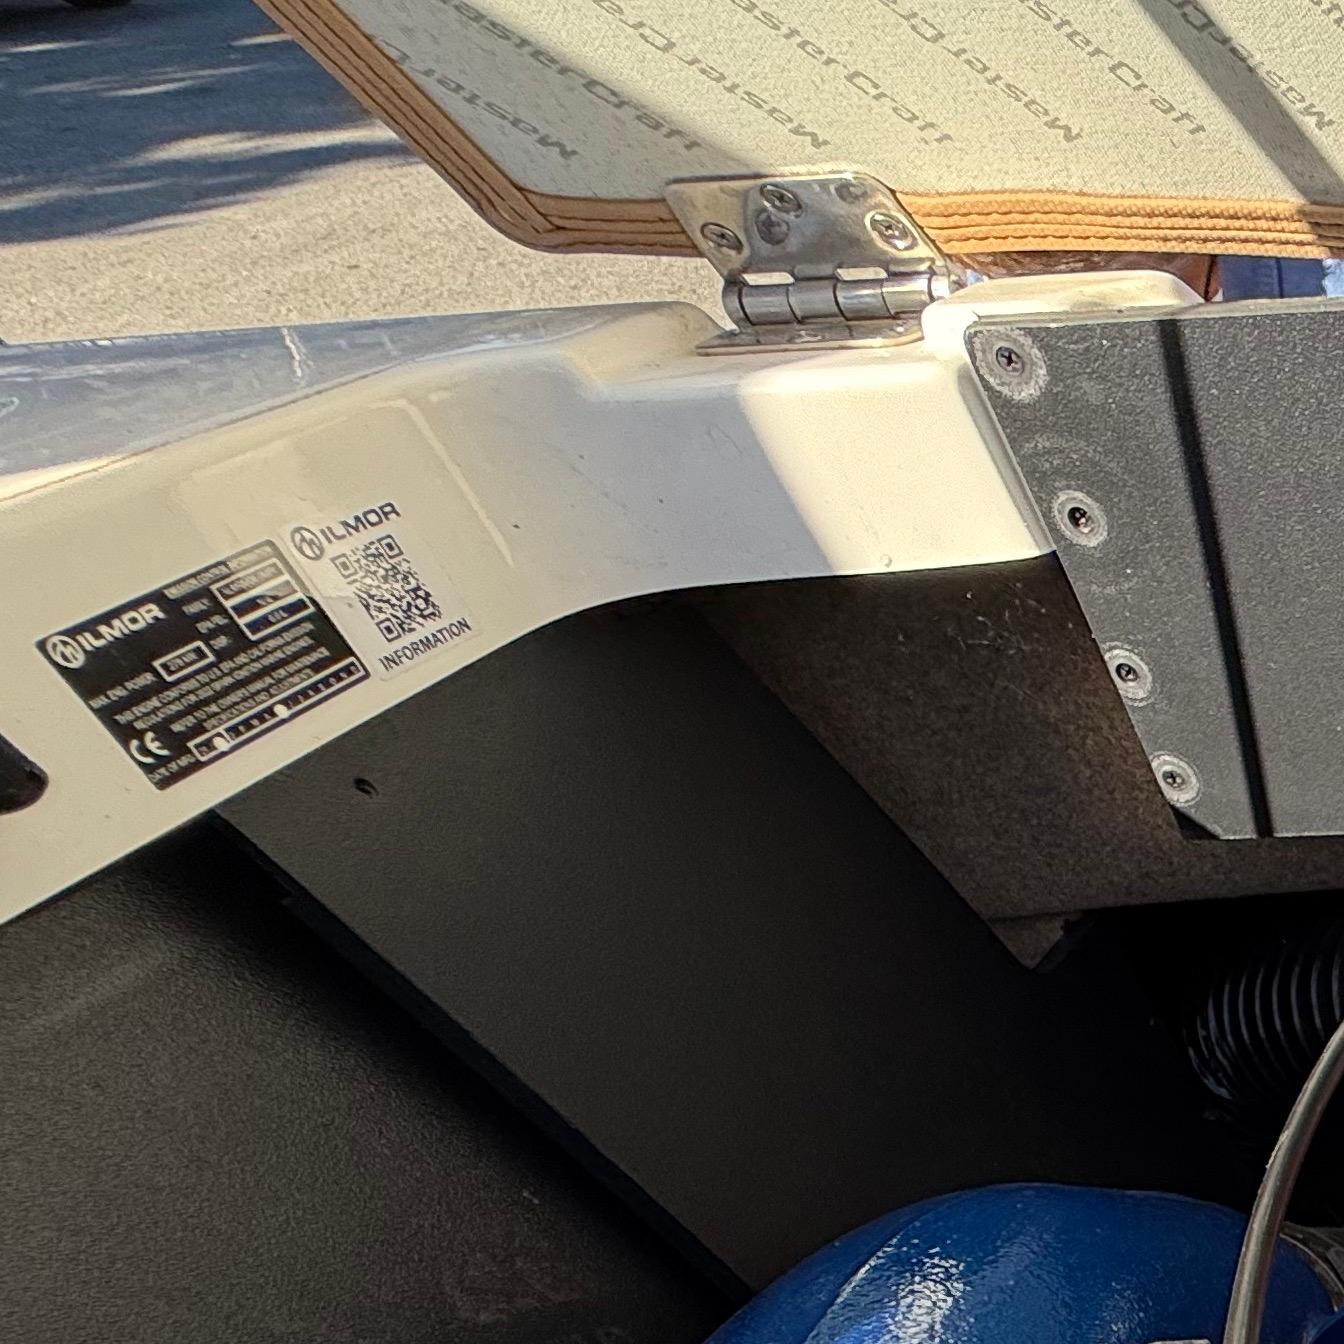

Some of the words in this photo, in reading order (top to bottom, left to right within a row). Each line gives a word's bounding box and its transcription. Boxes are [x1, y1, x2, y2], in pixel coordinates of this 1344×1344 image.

[321, 501, 401, 544] ILMOR
[79, 602, 168, 652] ILMOR
[378, 616, 472, 671] INFORMATION
